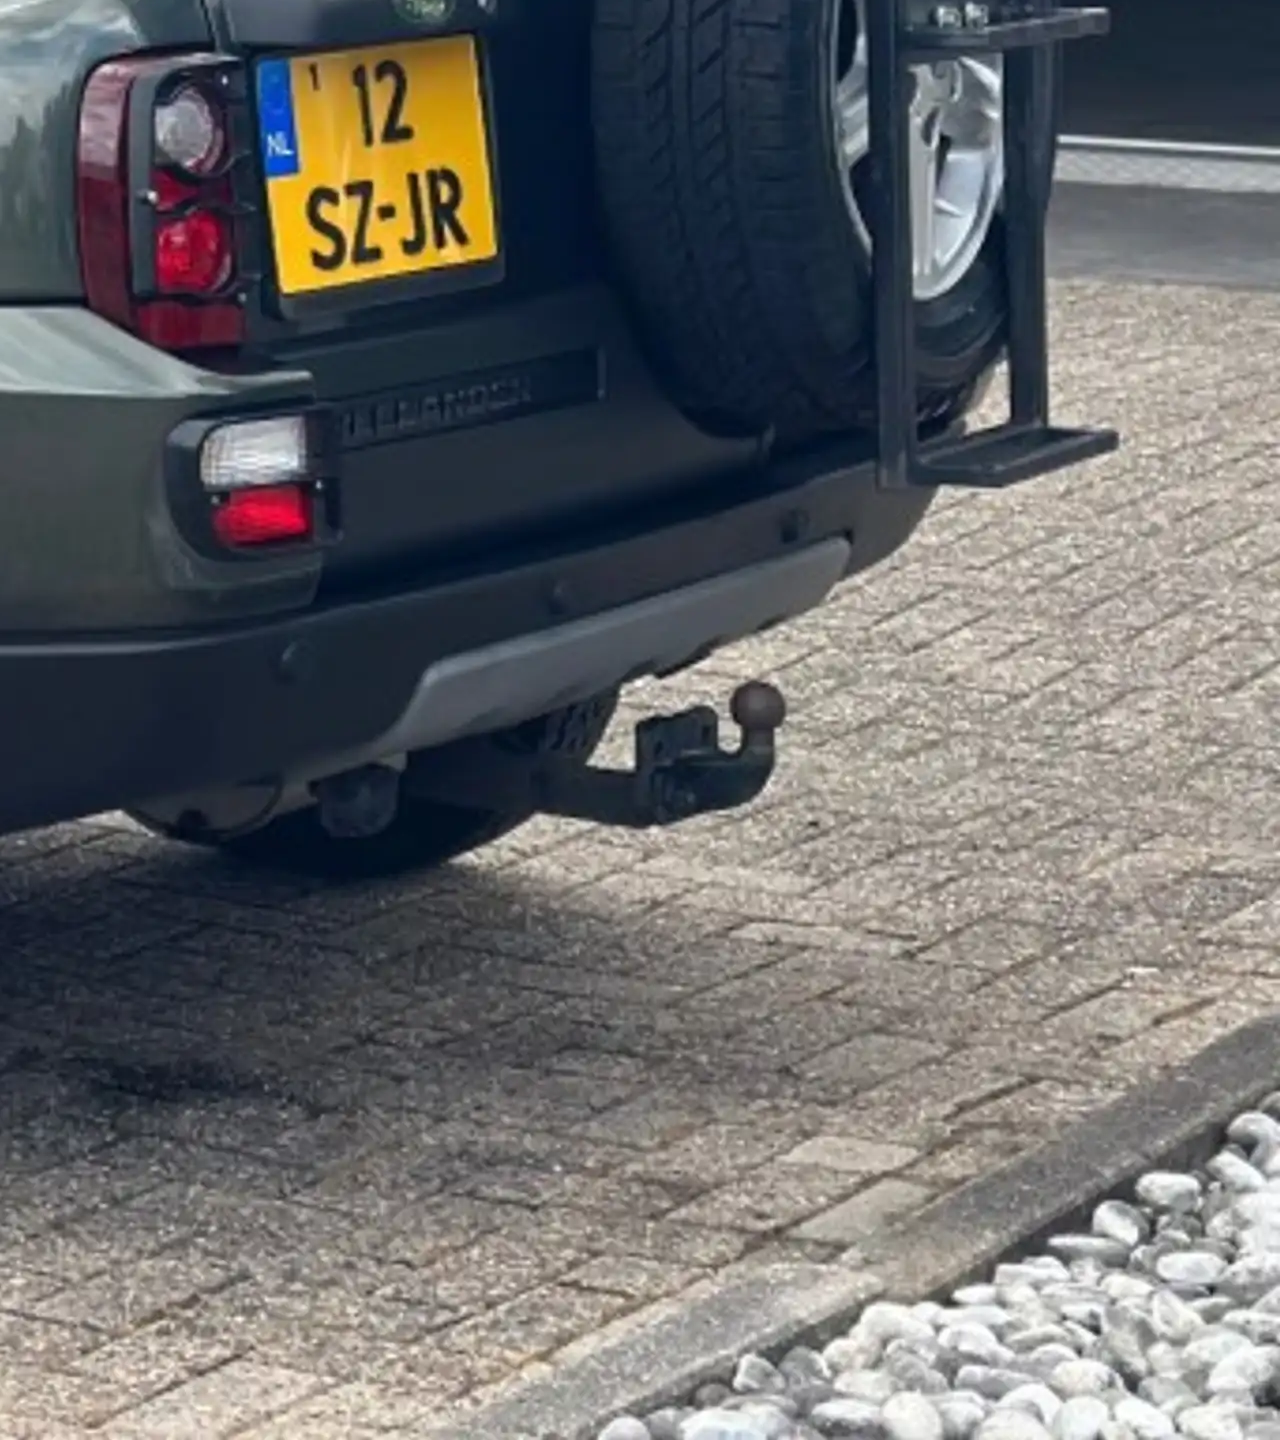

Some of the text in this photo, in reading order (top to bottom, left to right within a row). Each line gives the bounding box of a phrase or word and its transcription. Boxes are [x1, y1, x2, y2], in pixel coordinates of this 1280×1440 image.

[266, 130, 294, 157] NL
[352, 59, 415, 148] 12
[305, 165, 471, 272] SZ-JR
